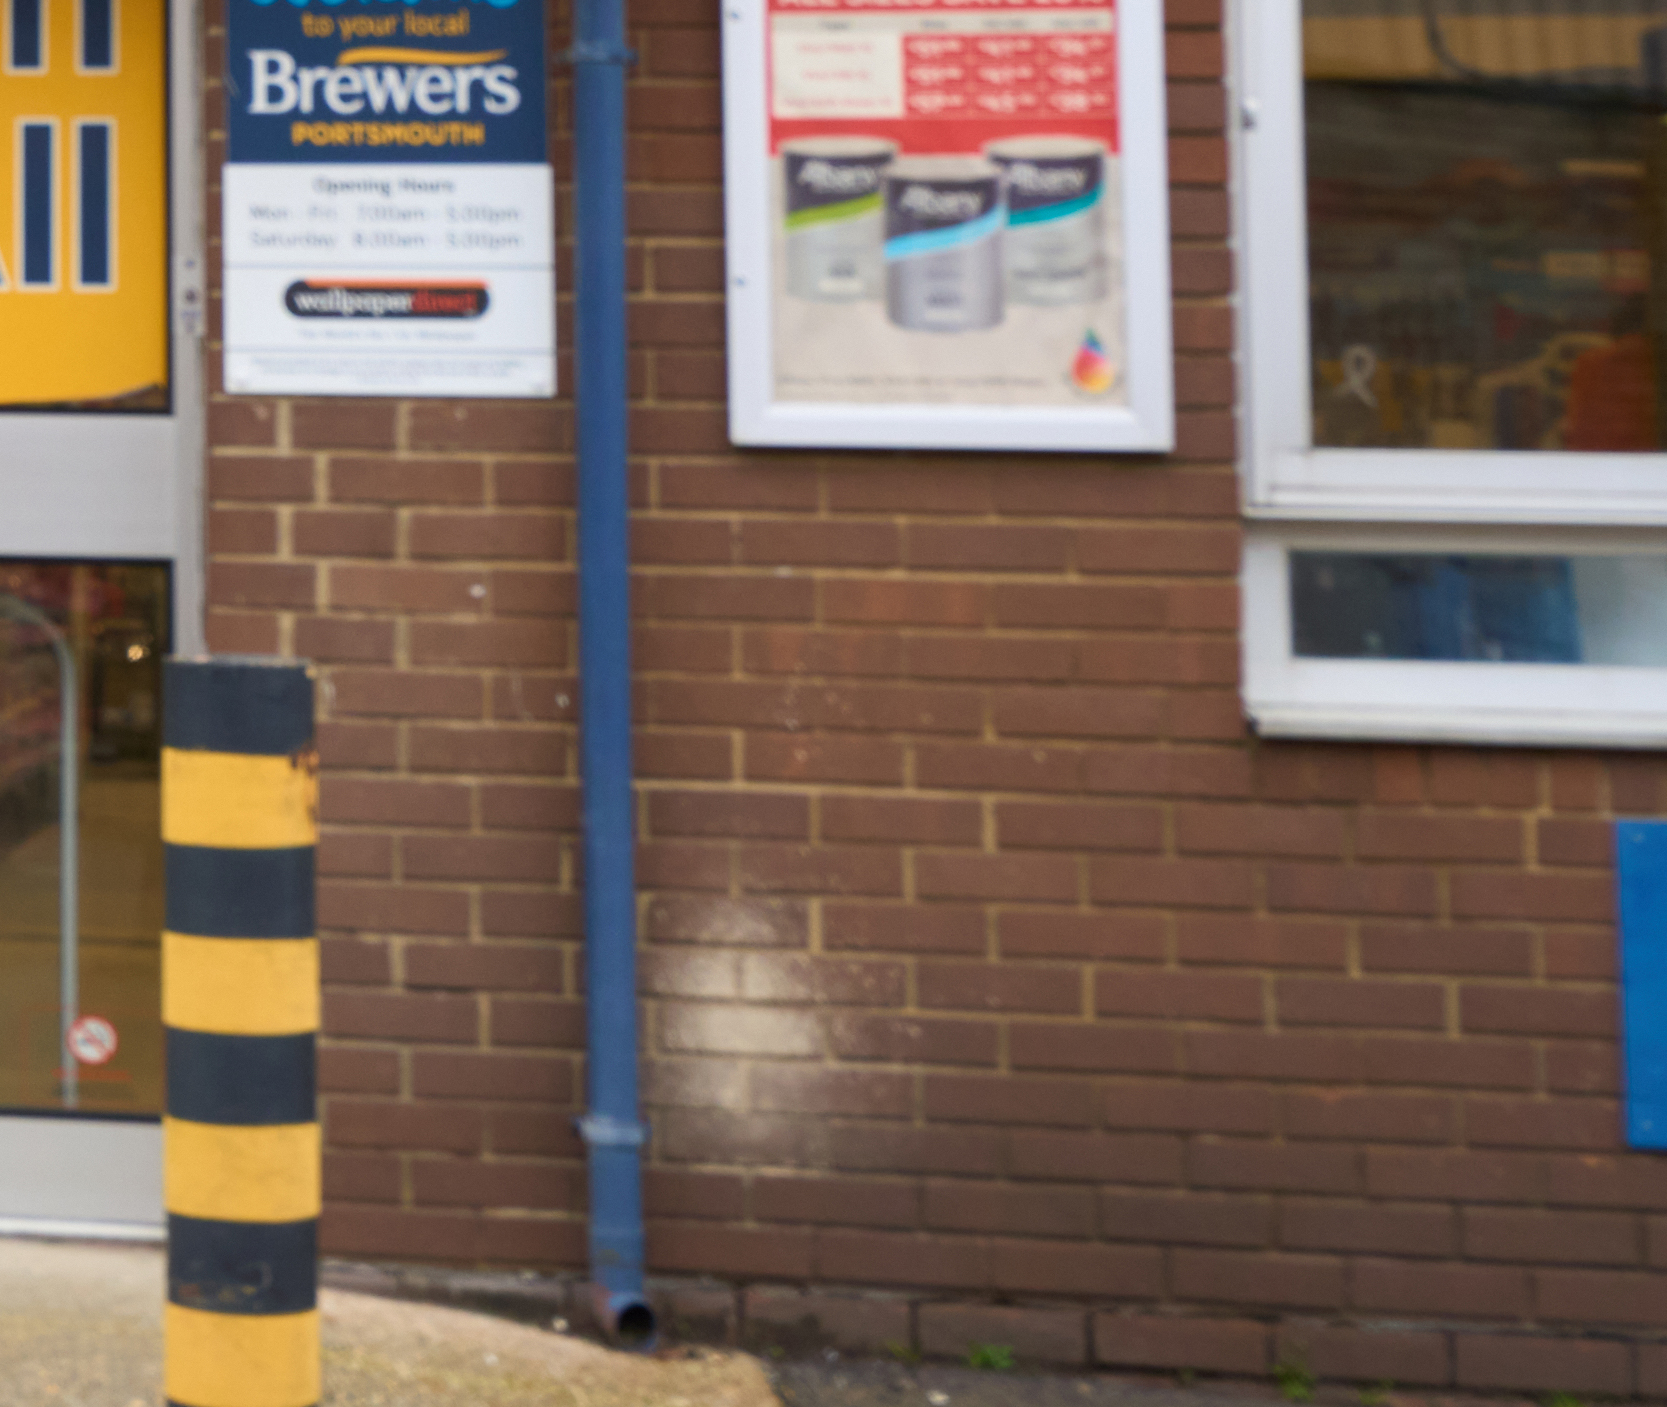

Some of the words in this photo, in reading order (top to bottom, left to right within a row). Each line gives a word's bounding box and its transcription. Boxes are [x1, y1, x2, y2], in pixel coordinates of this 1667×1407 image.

[301, 12, 334, 37] to
[340, 14, 398, 41] your
[404, 9, 469, 36] local
[246, 48, 521, 116] Brewers
[291, 121, 486, 146] PORTSMOUTH
